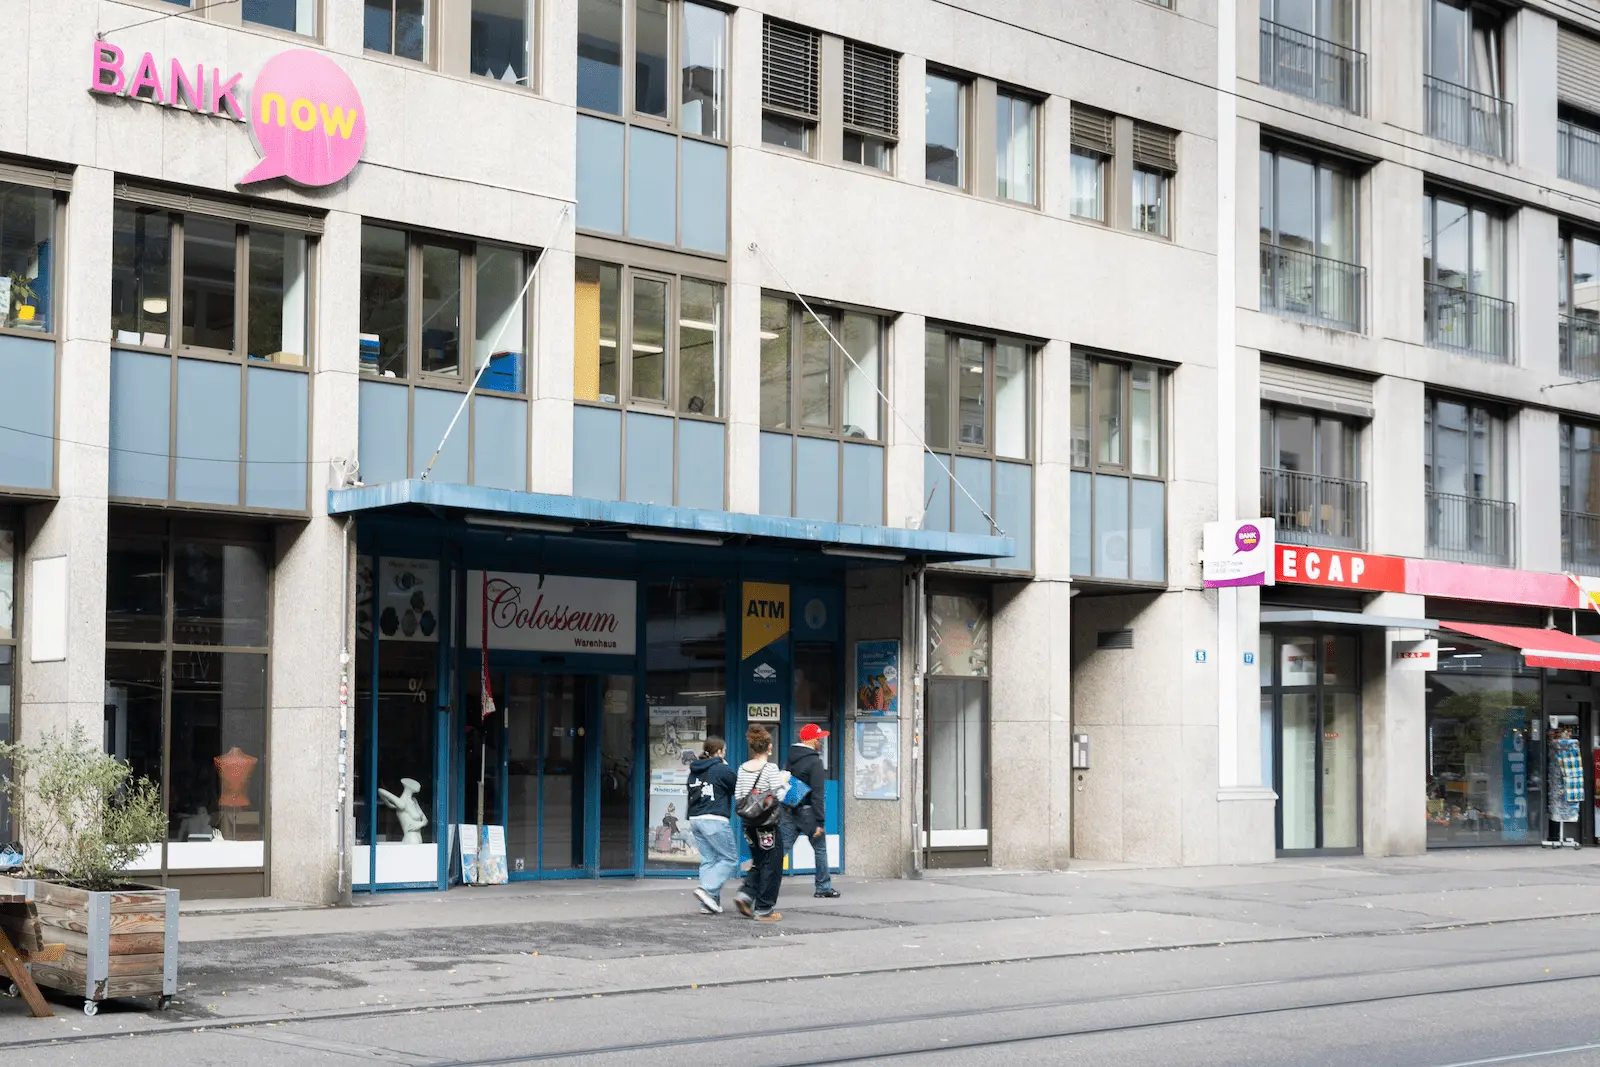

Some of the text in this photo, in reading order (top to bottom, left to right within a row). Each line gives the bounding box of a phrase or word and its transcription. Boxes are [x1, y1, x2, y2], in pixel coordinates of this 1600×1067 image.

[92, 40, 245, 120] BANK
[260, 92, 358, 140] now
[1238, 532, 1257, 540] BANK
[1282, 549, 1365, 584] ECAP
[486, 577, 619, 633] Colosseum
[746, 599, 785, 619] ATM
[574, 638, 617, 649] Warenhaus
[748, 706, 778, 718] CASH
